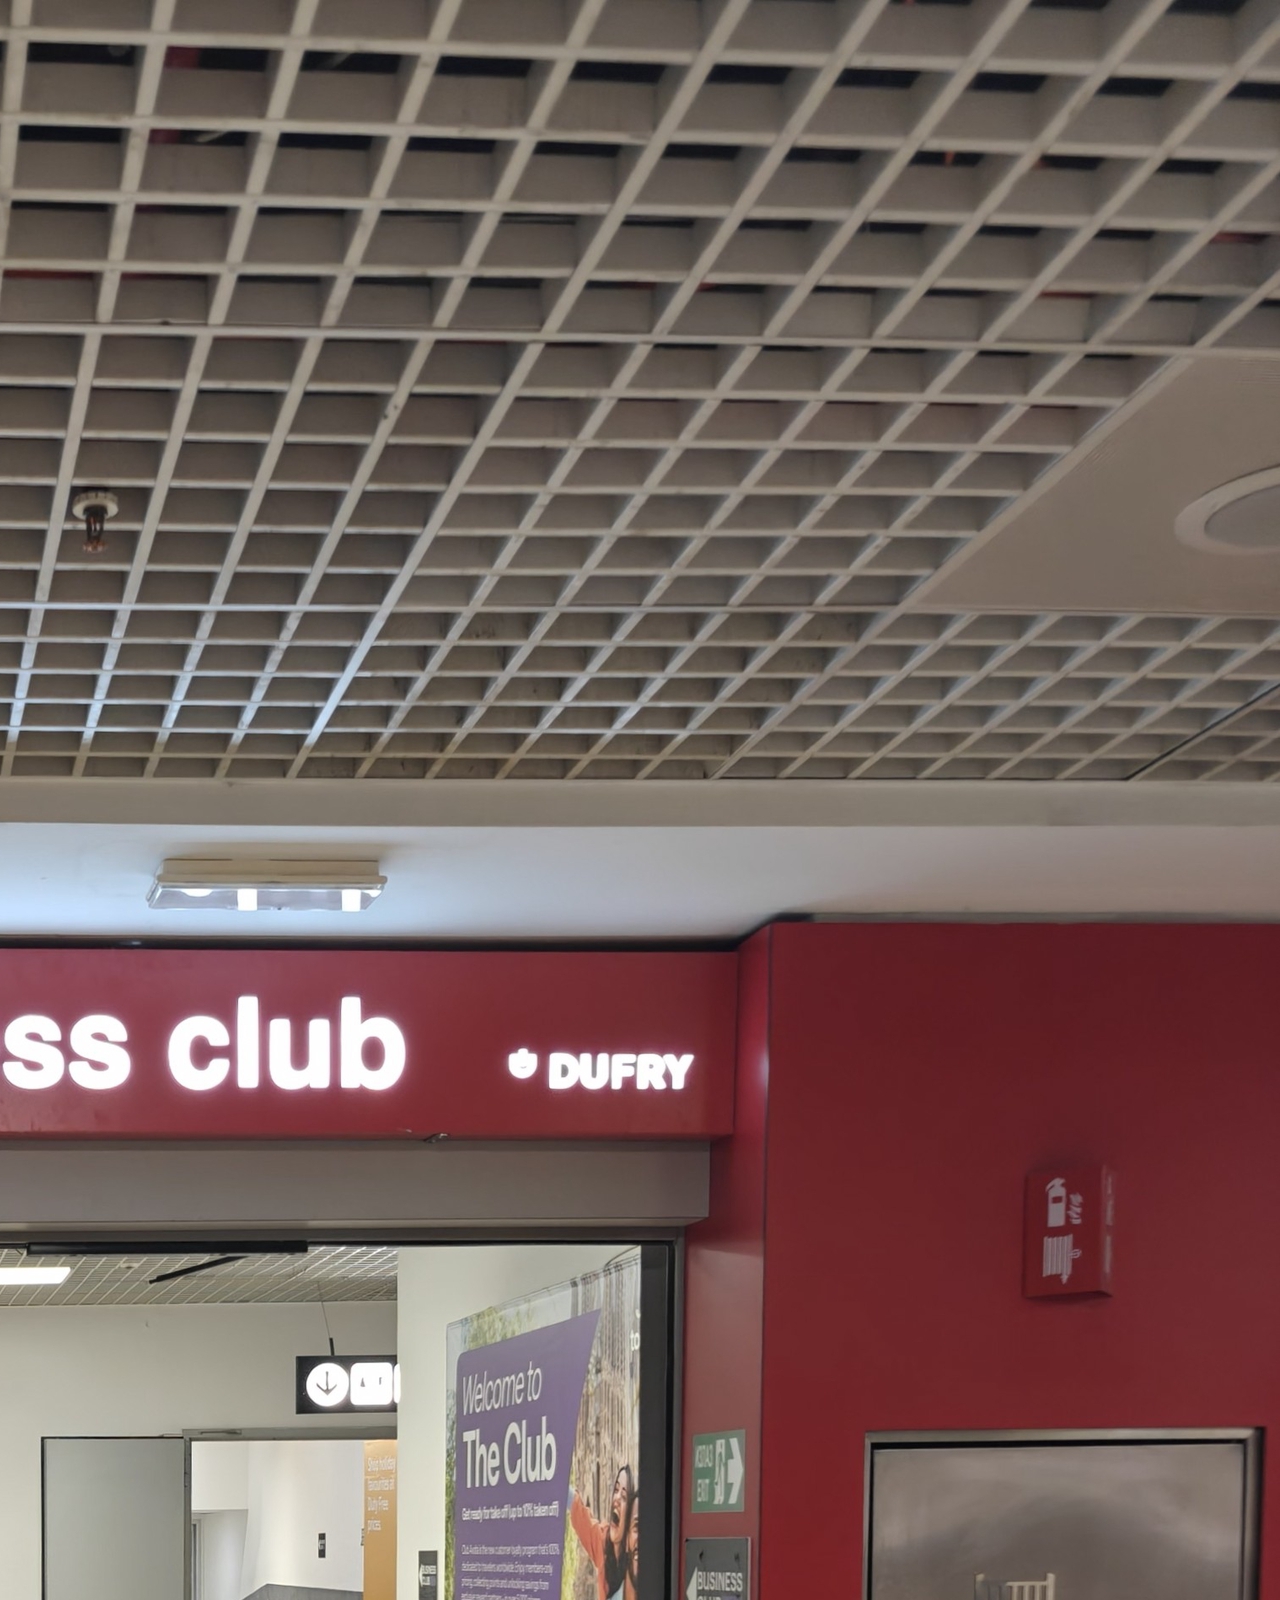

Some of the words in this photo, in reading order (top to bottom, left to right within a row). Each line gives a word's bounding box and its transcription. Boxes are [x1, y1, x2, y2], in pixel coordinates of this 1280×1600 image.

[167, 994, 407, 1092] club
[547, 1051, 694, 1092] DUFRY
[462, 1369, 524, 1415] Welcome
[527, 1361, 542, 1401] to
[462, 1429, 498, 1488] The
[503, 1416, 557, 1484] Club
[696, 1570, 743, 1592] BUSINESS
